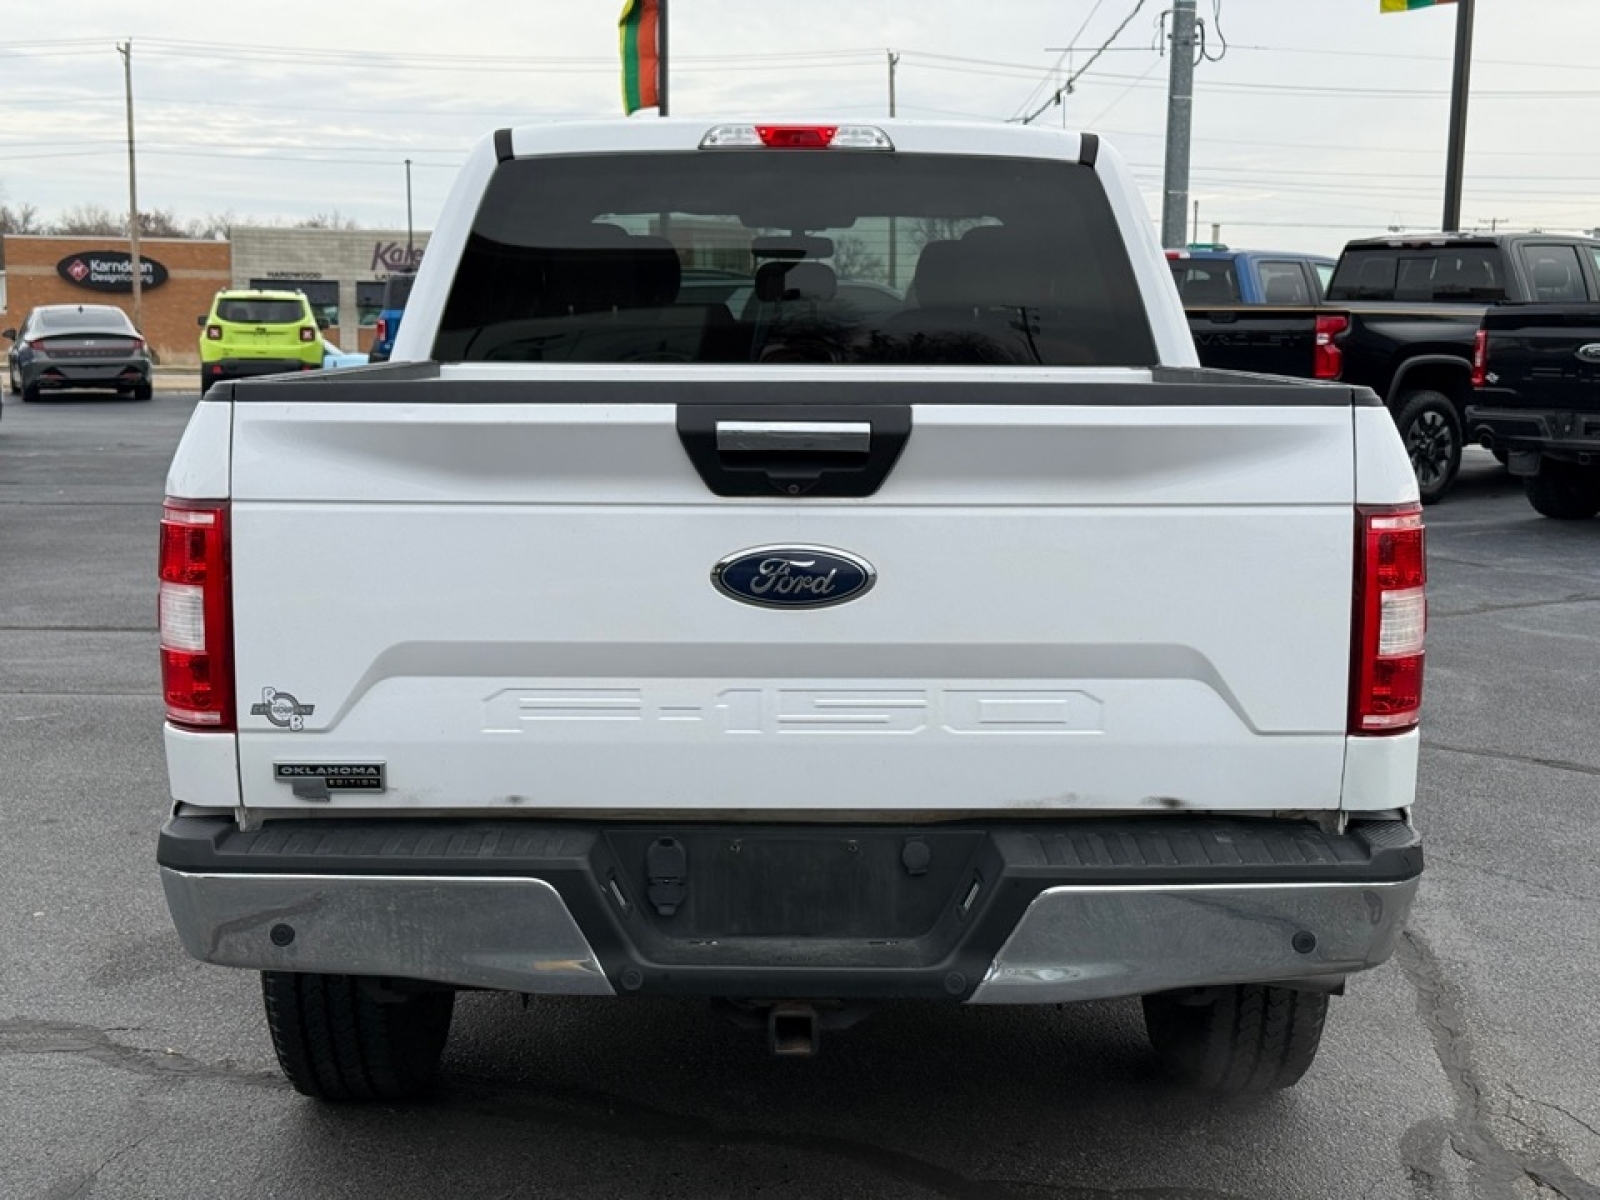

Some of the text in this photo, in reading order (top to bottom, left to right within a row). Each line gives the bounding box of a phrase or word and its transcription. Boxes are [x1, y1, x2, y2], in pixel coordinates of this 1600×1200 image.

[751, 558, 837, 594] Ford
[481, 687, 1105, 733] F-150
[281, 766, 378, 774] OKLAHOMA
